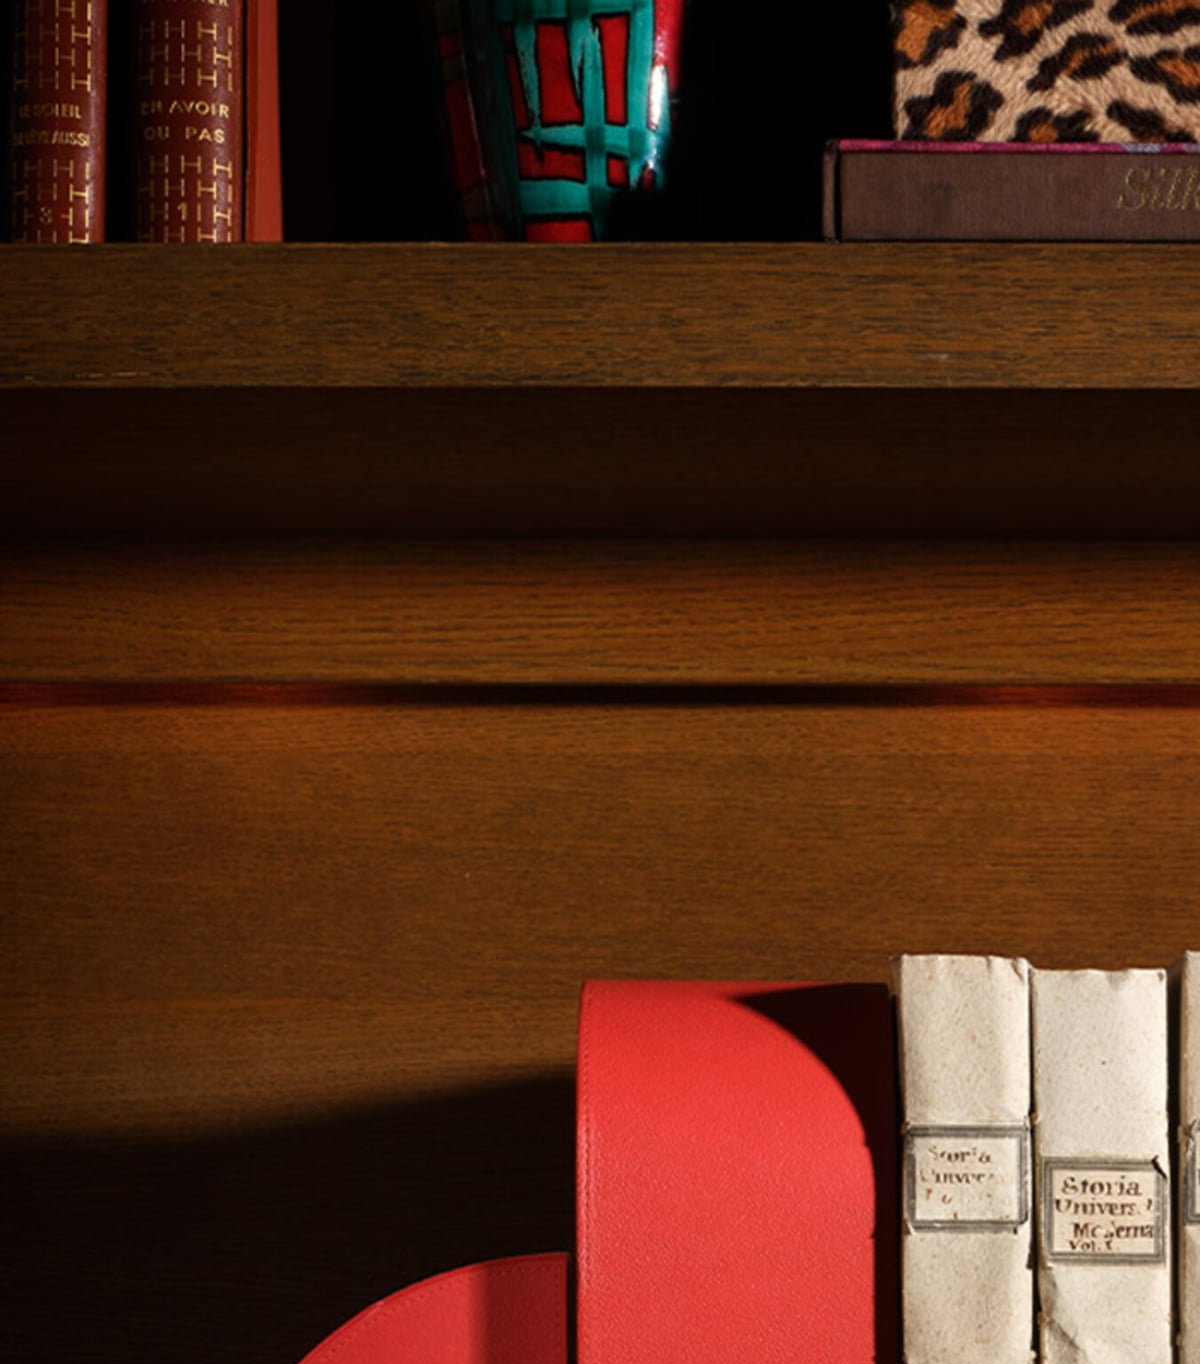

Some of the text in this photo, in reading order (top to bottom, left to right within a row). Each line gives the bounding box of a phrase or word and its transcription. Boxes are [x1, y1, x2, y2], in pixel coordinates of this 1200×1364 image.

[168, 99, 230, 118] AVOIR
[143, 126, 226, 144] OU PAS
[1060, 1174, 1143, 1197] Storia
